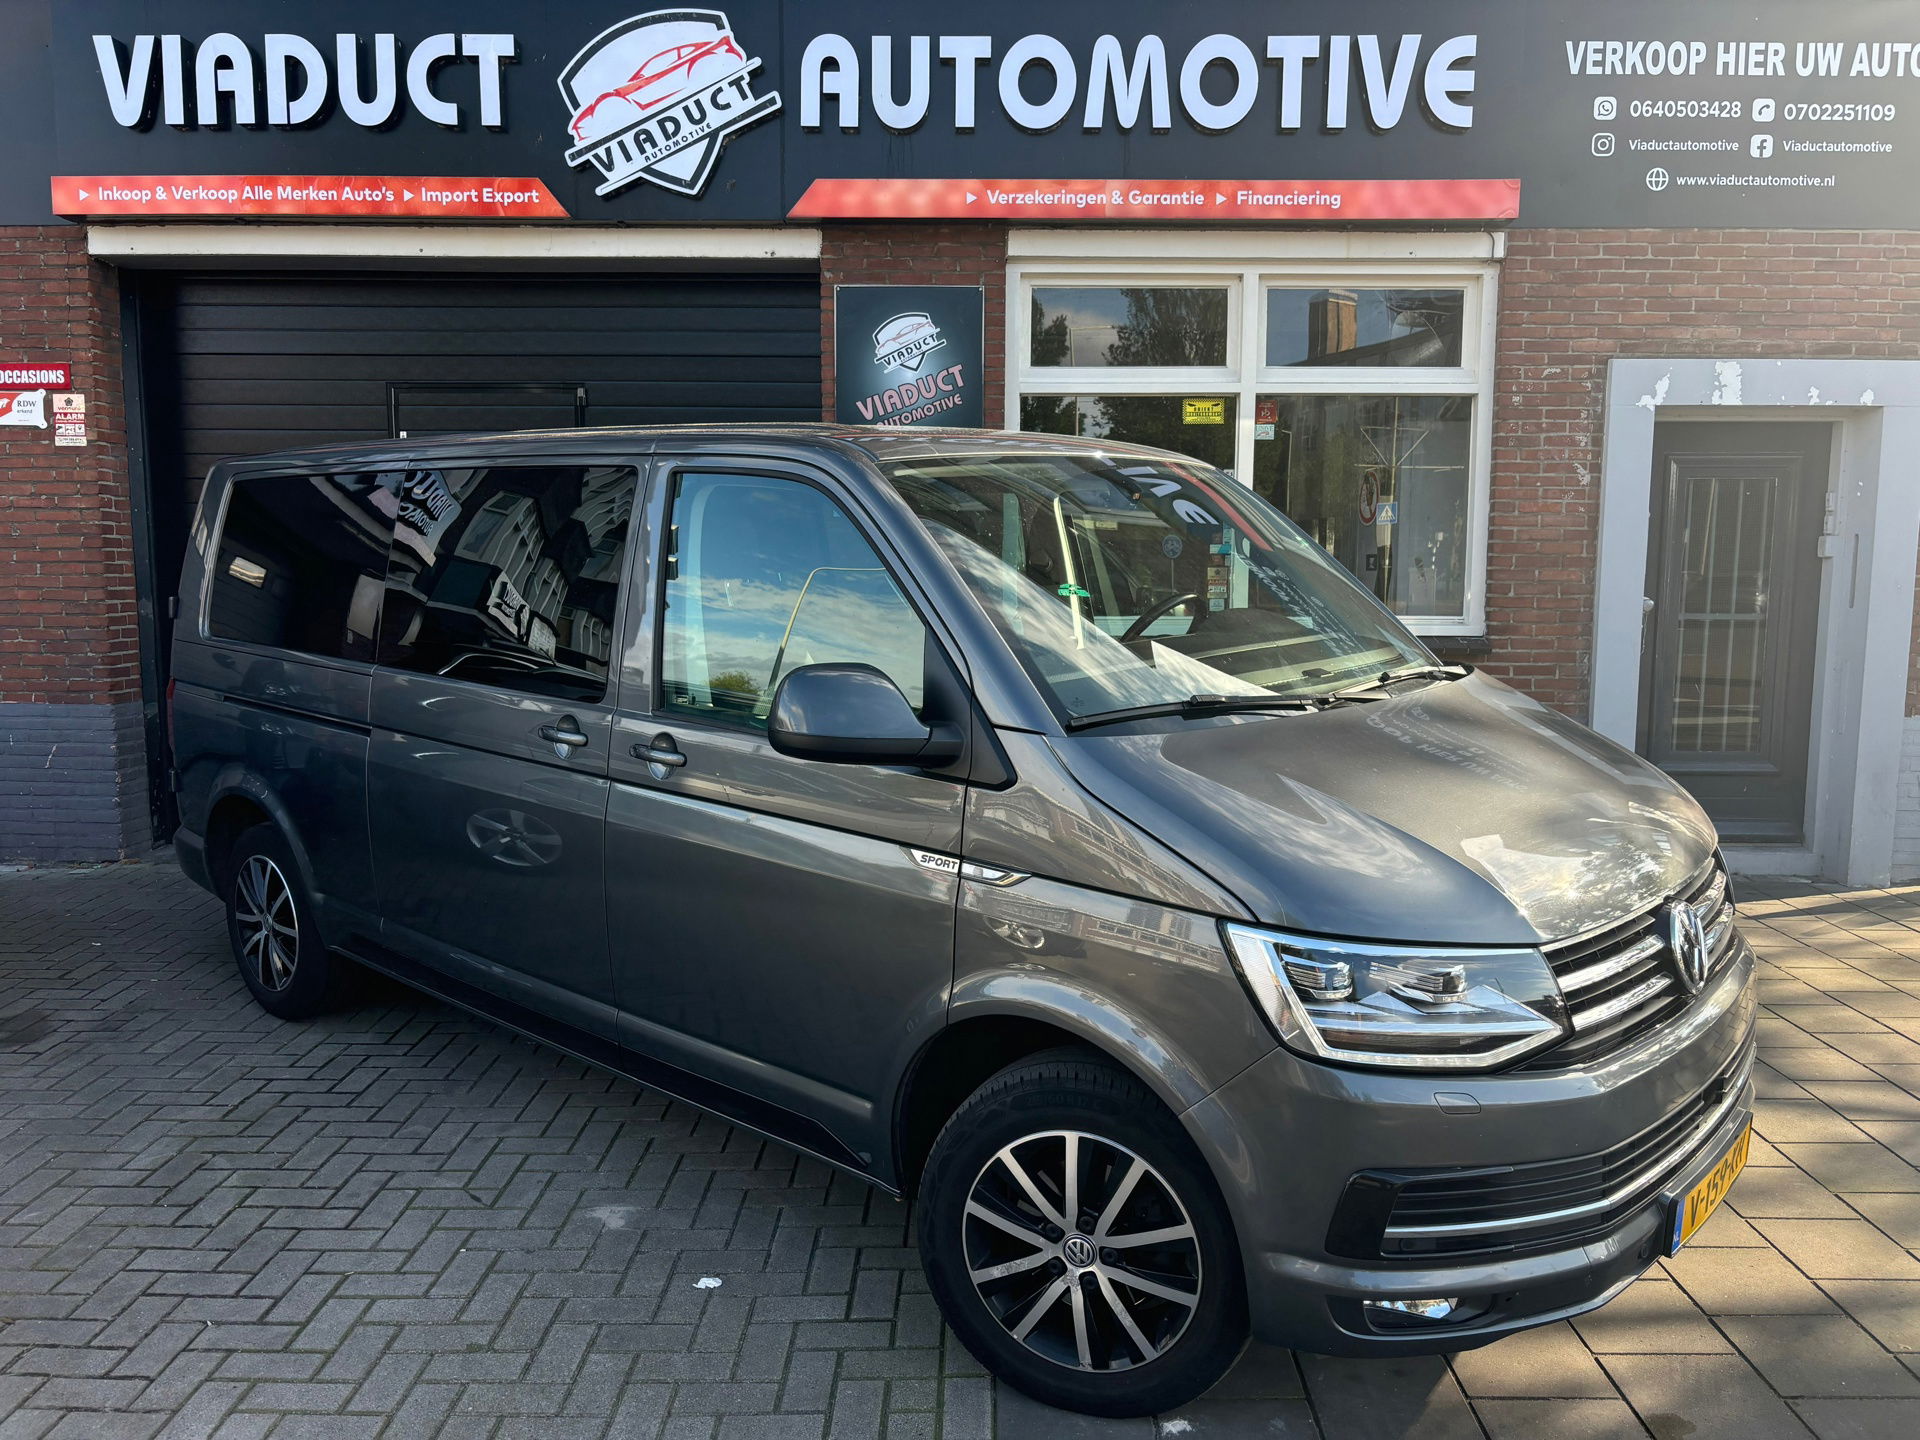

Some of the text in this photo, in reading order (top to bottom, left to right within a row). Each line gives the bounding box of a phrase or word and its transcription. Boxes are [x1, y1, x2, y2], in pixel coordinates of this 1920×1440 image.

[1566, 40, 1707, 75] VERKOOP
[1716, 42, 1785, 76] HIER
[1795, 42, 1843, 77] UW
[92, 33, 515, 127] VIADUCT
[800, 34, 1476, 129] AUTOMOTIVE
[1629, 100, 1742, 118] 0640503428
[1784, 104, 1896, 121] 0702251109
[592, 75, 750, 173] VIADUCT
[644, 122, 712, 163] AUTOMOTIVE
[1629, 139, 1739, 151] Viaductautomotive
[1783, 140, 1893, 153] Viaductautomotive
[1676, 174, 1836, 187] www.viaductautomotive.nl
[98, 185, 395, 203] Inkoop & Verkoop Alle Merken Auto's
[421, 187, 540, 205] Import Export
[986, 189, 1205, 208] Verzekeringen & Garantie
[1236, 190, 1341, 208] Financiering
[884, 334, 937, 366] VIADUCT
[855, 363, 965, 421] VIADUCT
[920, 854, 958, 870] SPORT
